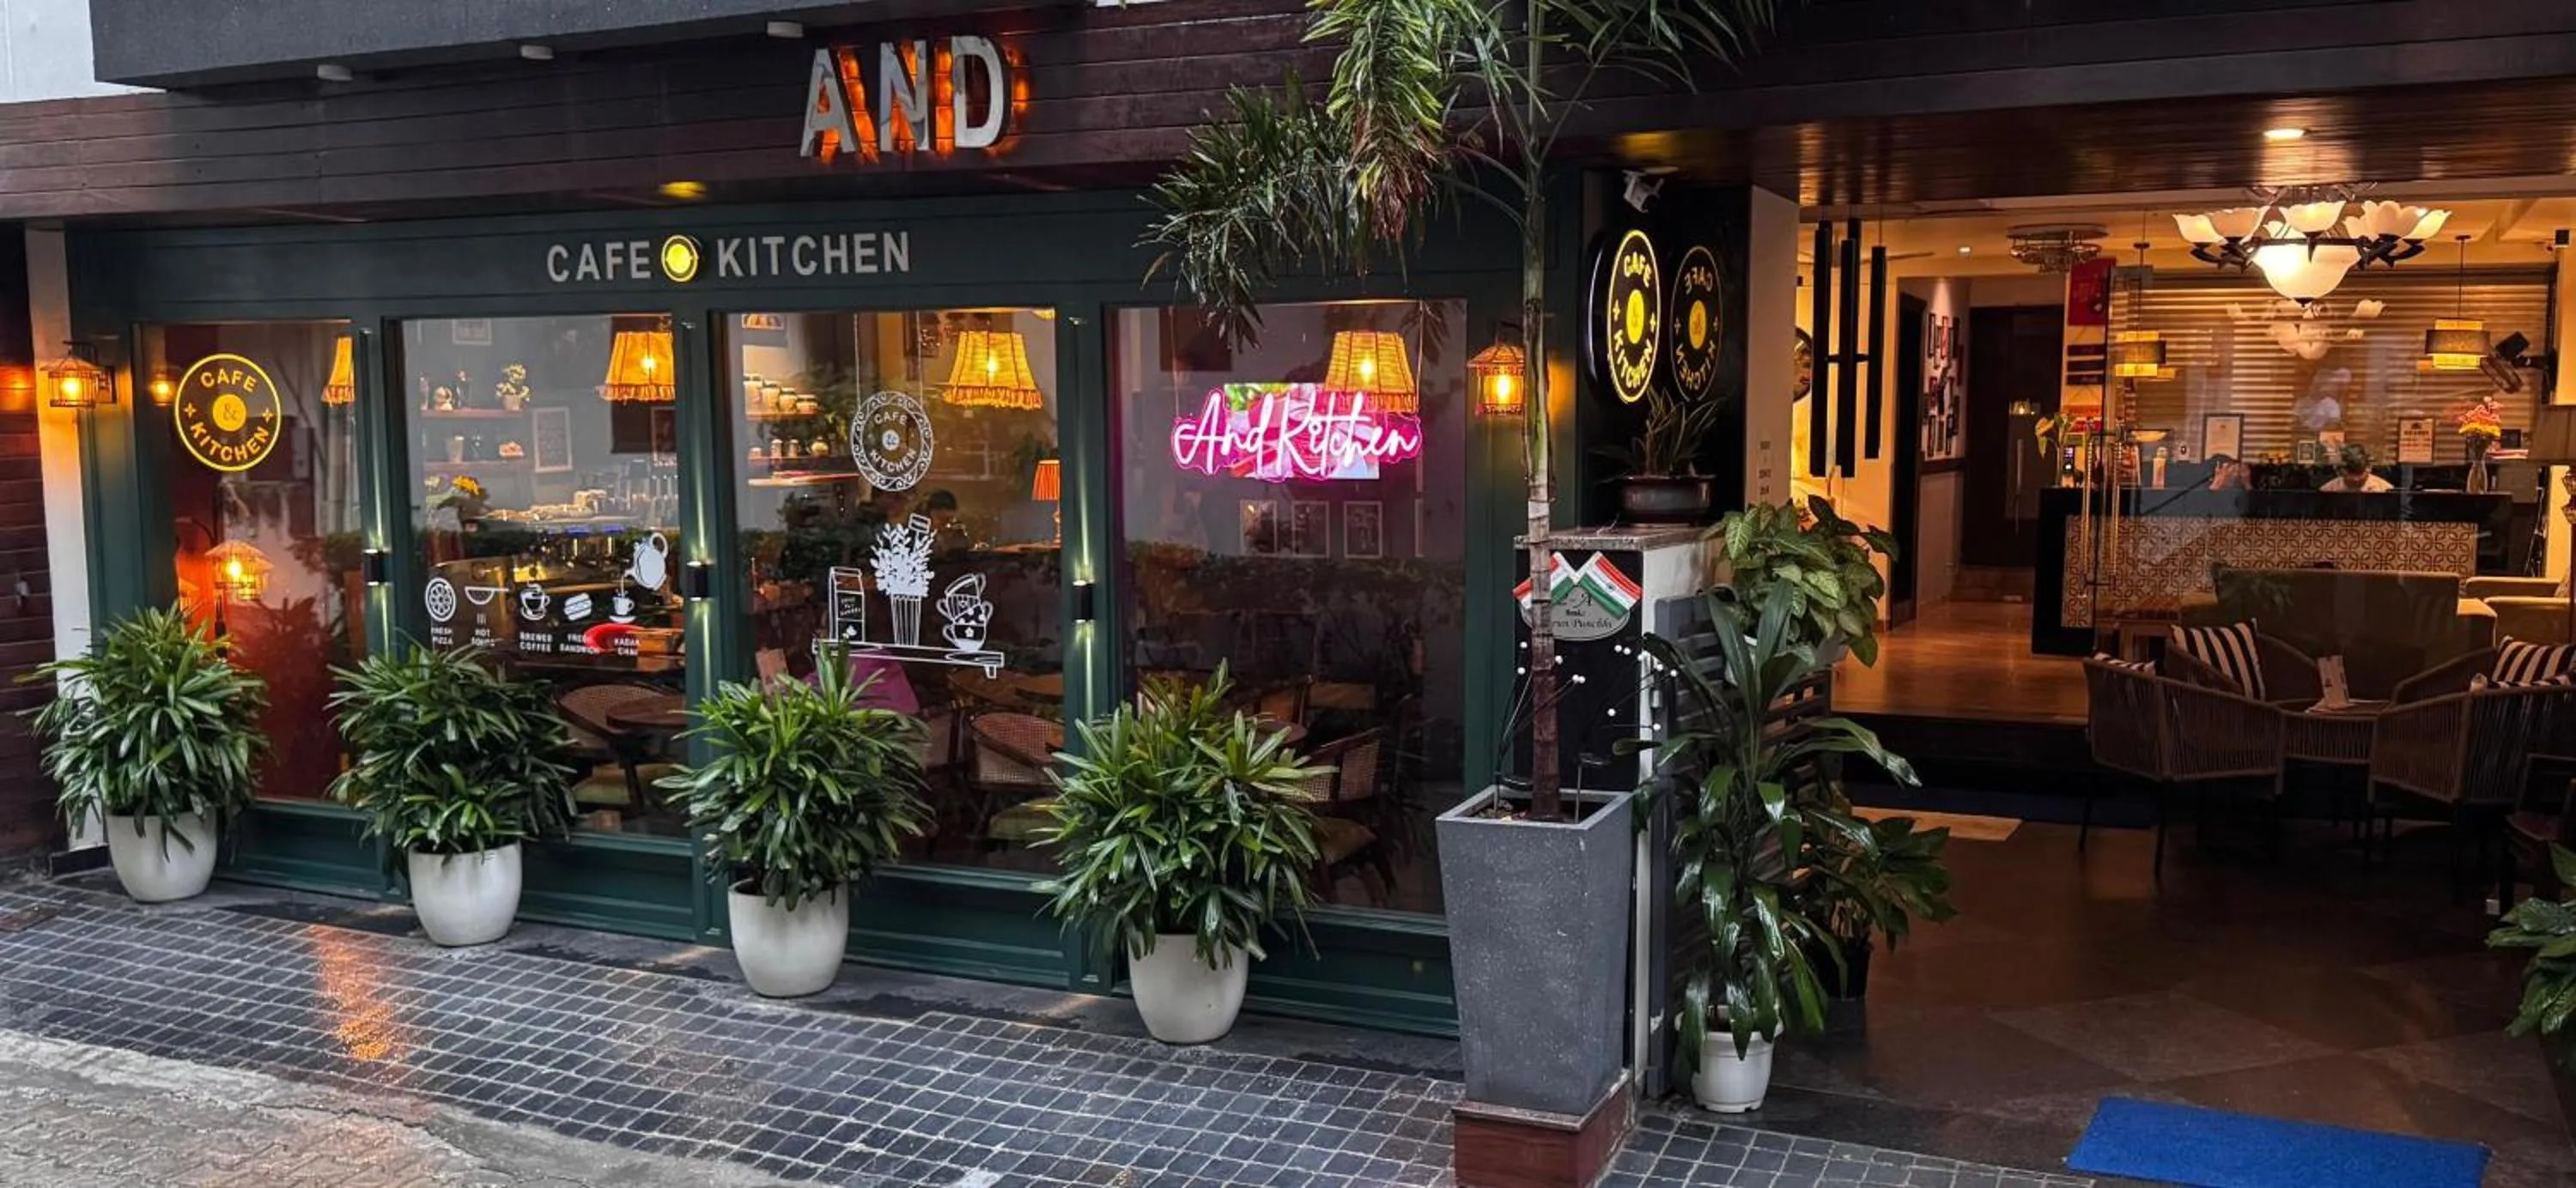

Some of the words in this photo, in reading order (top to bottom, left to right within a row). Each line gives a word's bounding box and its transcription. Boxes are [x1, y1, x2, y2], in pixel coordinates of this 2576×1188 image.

[799, 35, 1004, 157] AND
[547, 240, 652, 282] CAFE
[717, 231, 909, 277] KITCHEN
[1624, 252, 1652, 288] CAFE
[1614, 330, 1652, 388] KITCHEN
[200, 368, 257, 392] CAFE
[223, 403, 237, 421] &
[874, 412, 908, 426] CAFE
[190, 421, 269, 461] KITCHEN
[1174, 391, 1275, 475] And
[1276, 391, 1419, 475] Kitchen
[870, 447, 916, 473] KITCHEN
[432, 636, 453, 646] PIZZA
[475, 628, 490, 637] HOT
[519, 631, 553, 643] BREWED
[614, 638, 641, 646] KADAK
[519, 641, 551, 652] COFFEE
[617, 646, 639, 657] CHAI
